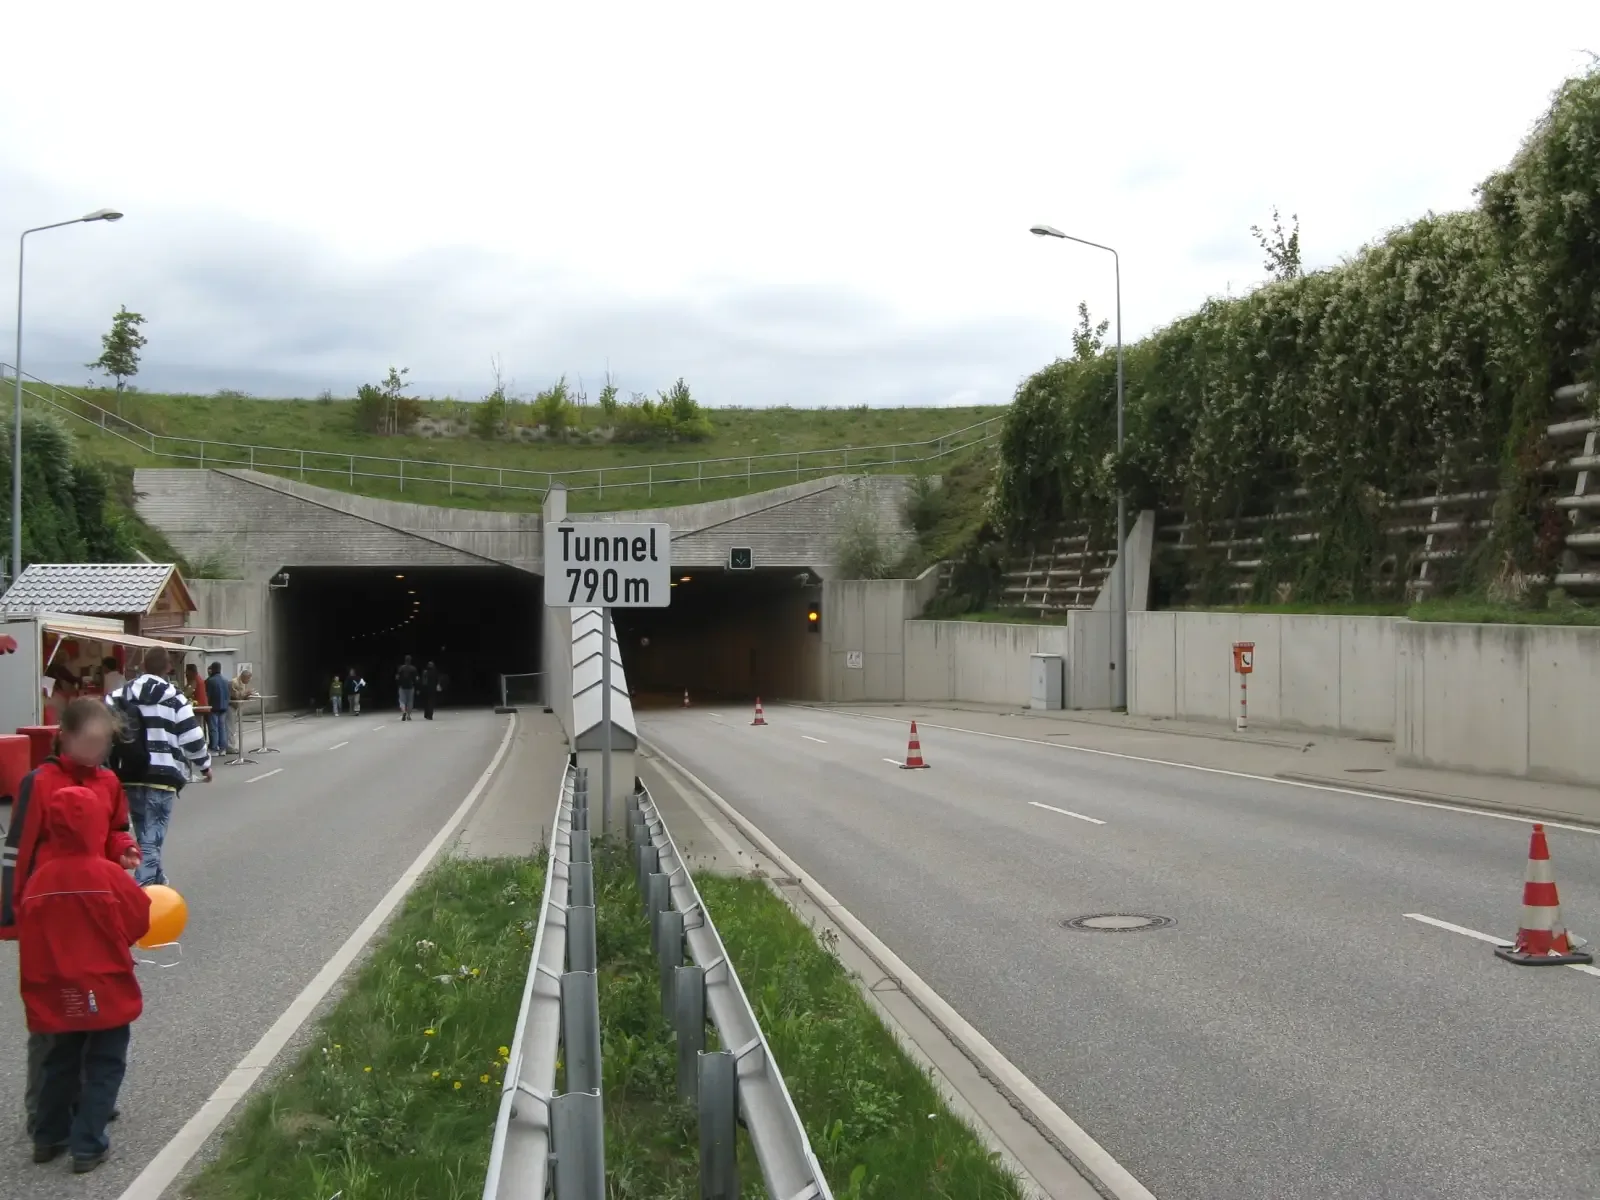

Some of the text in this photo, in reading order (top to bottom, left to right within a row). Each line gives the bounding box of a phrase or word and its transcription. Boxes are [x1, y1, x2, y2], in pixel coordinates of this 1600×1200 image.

[558, 527, 658, 562] Tunnel
[566, 568, 649, 603] 790 m
